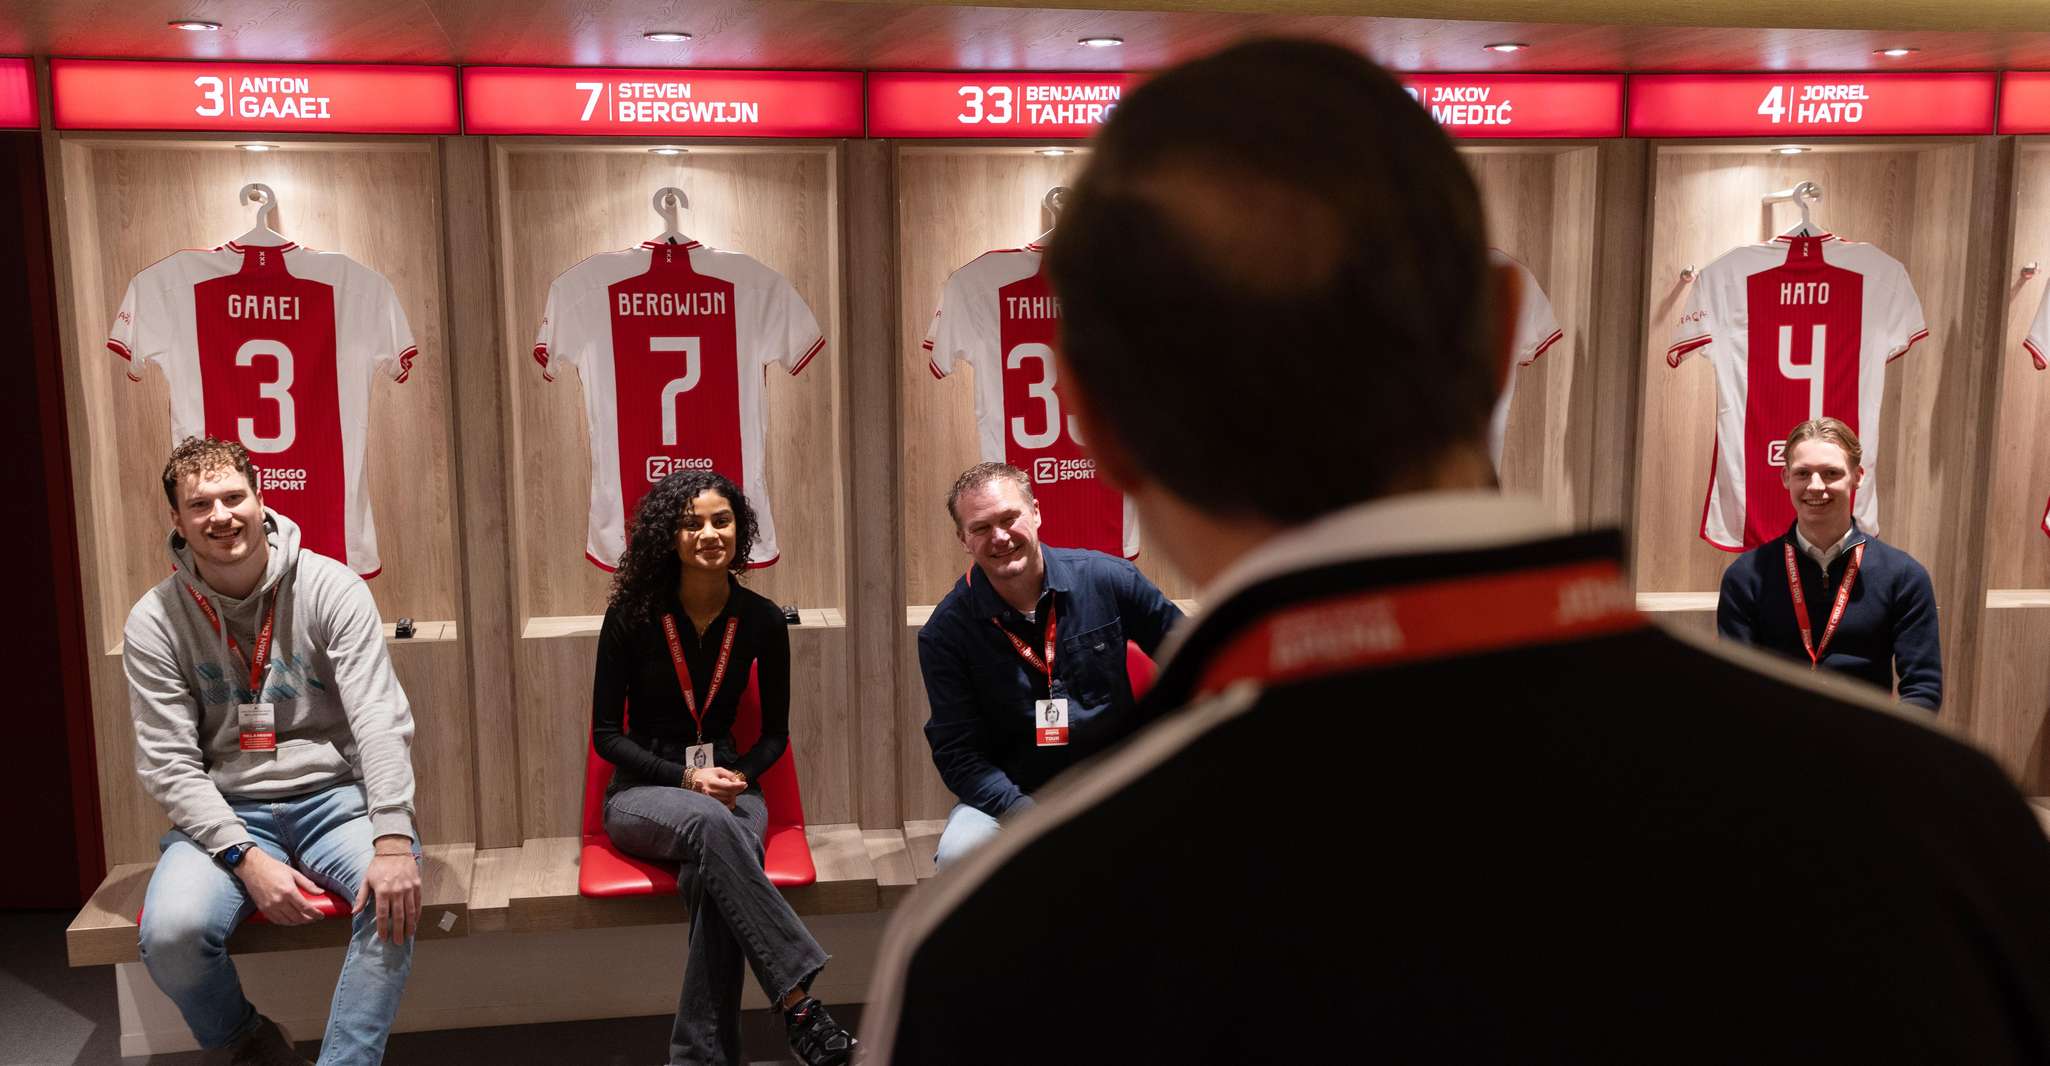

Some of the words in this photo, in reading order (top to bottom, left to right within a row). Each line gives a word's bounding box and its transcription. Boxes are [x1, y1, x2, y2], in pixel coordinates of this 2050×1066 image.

[194, 77, 225, 117] 3
[239, 77, 309, 94] ANTON
[618, 83, 691, 98] STEVEN
[1026, 86, 1121, 101] BENJAMIN
[1431, 87, 1490, 102] JAKOV
[1800, 84, 1869, 101] JORREL
[239, 96, 331, 119] GAAEI
[575, 82, 603, 121] 7
[618, 101, 759, 123] BERGWIJN
[957, 86, 1012, 124] 33
[1431, 100, 1512, 125] MEDIĆ
[1757, 86, 1786, 123] 4
[1797, 102, 1863, 123] HATO
[618, 292, 726, 316] BERGWIJN
[1780, 282, 1830, 305] HATO
[228, 294, 300, 320] GAAEI
[1778, 324, 1826, 420] 4
[235, 339, 296, 453] 3
[650, 336, 701, 446] 7
[1007, 343, 1087, 449] 3
[263, 468, 307, 480] ZIGGO
[674, 458, 713, 469] ZIGGO
[1060, 459, 1096, 470] ZIGGO
[1060, 469, 1096, 480] SPORT
[263, 480, 307, 490] SPORT
[723, 622, 735, 650] ARENA
[256, 636, 267, 665] JOHAN
[671, 641, 683, 664] TOUR
